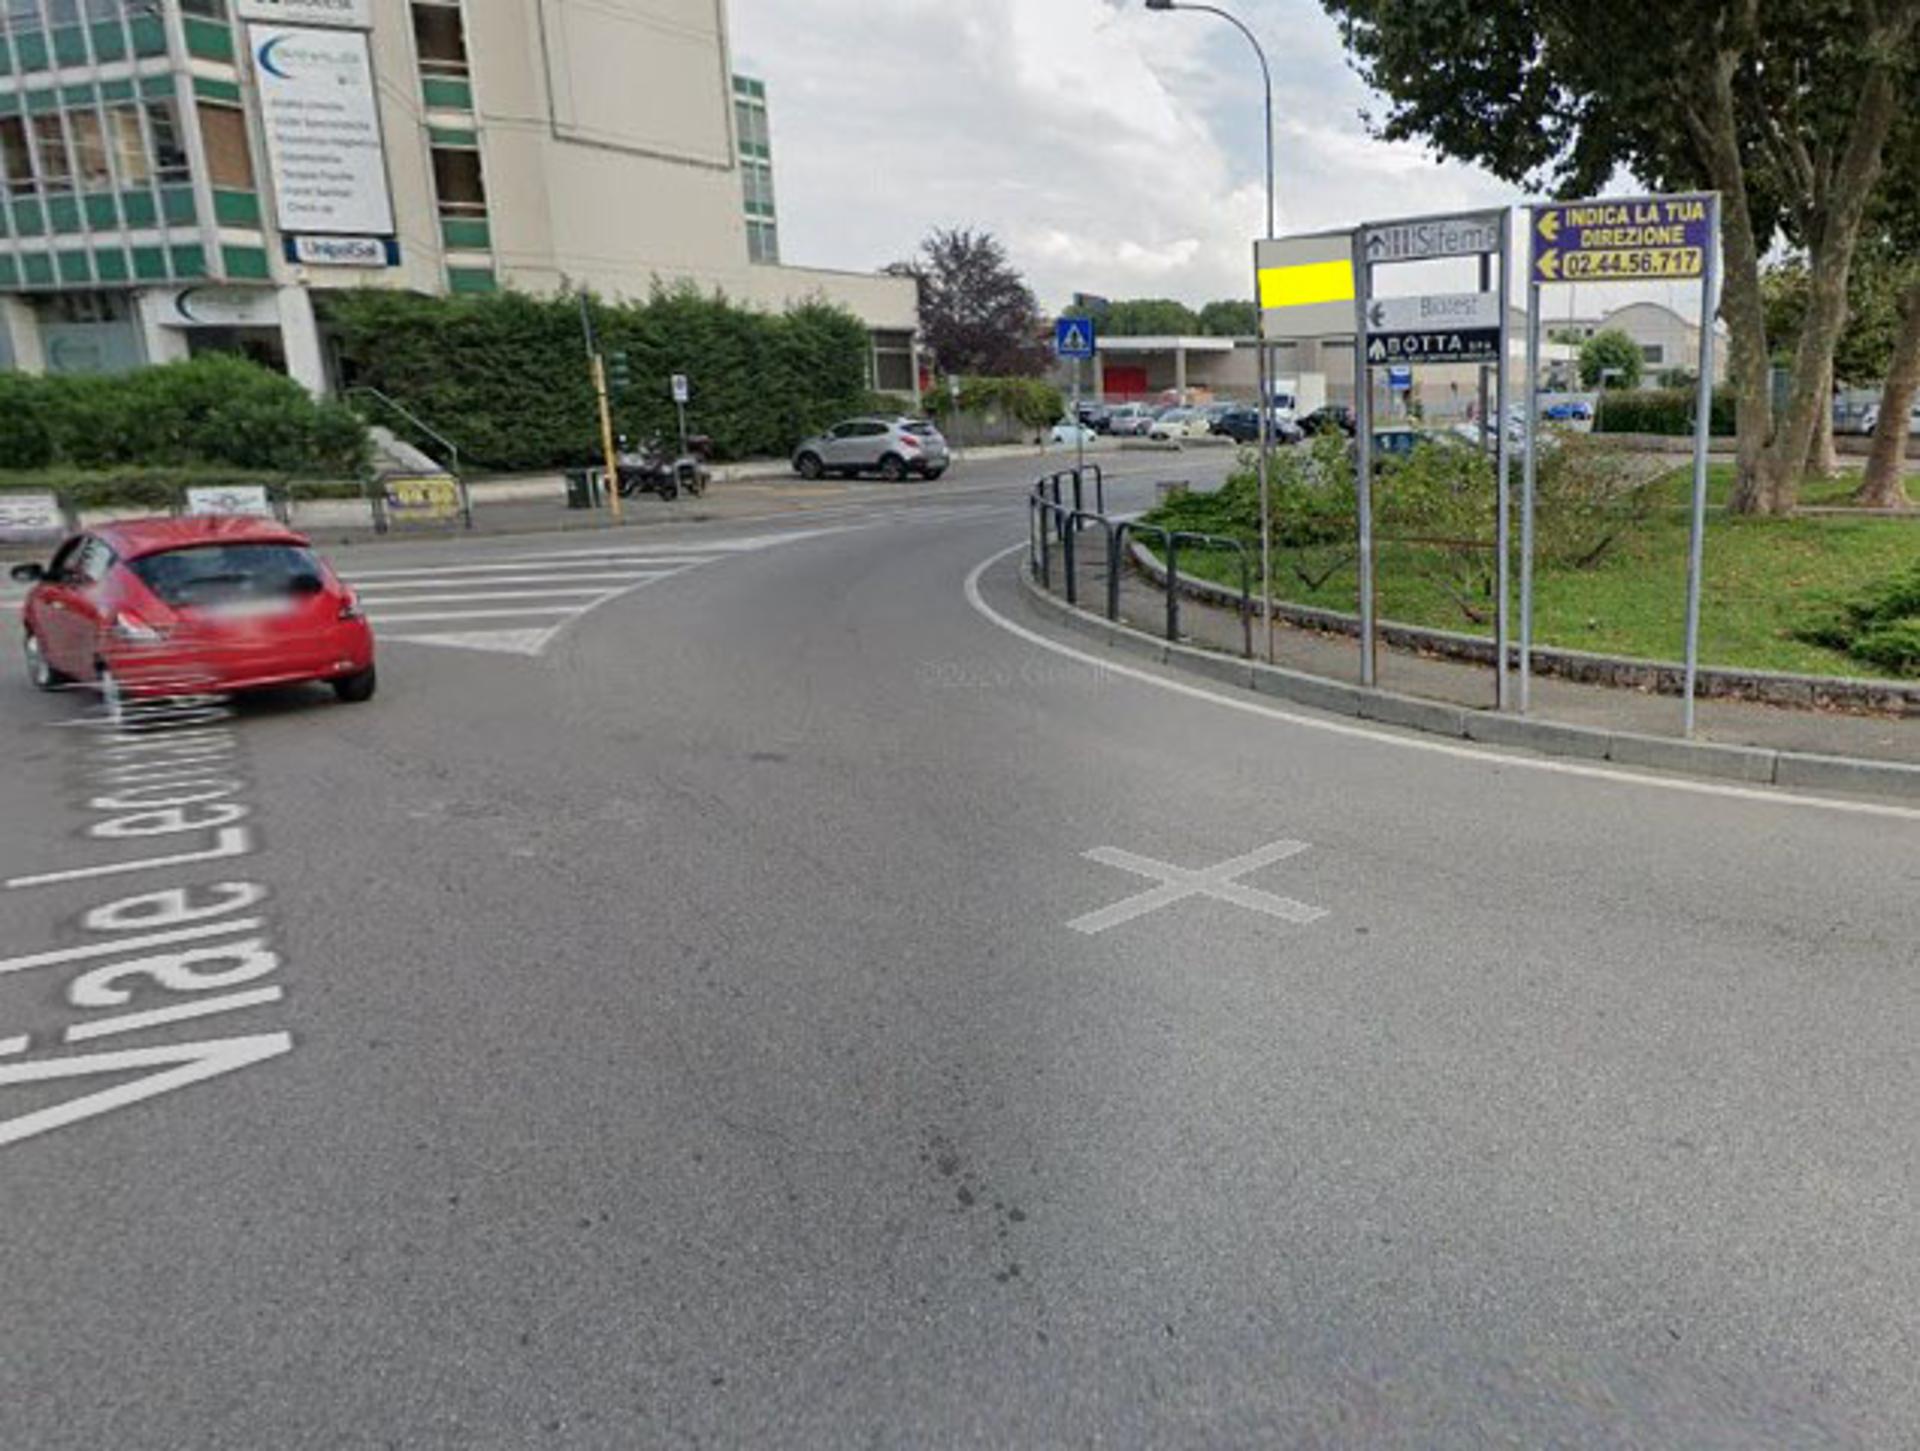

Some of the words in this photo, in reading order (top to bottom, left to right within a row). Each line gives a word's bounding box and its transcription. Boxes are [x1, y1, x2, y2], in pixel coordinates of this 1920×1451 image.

[1566, 206, 1629, 227] INDICA
[1635, 204, 1660, 223] LA
[1666, 202, 1705, 221] TUA
[1581, 226, 1685, 247] DIREZIONE
[1568, 250, 1698, 275] 02.44.56.717
[0, 876, 292, 1144] Viale
